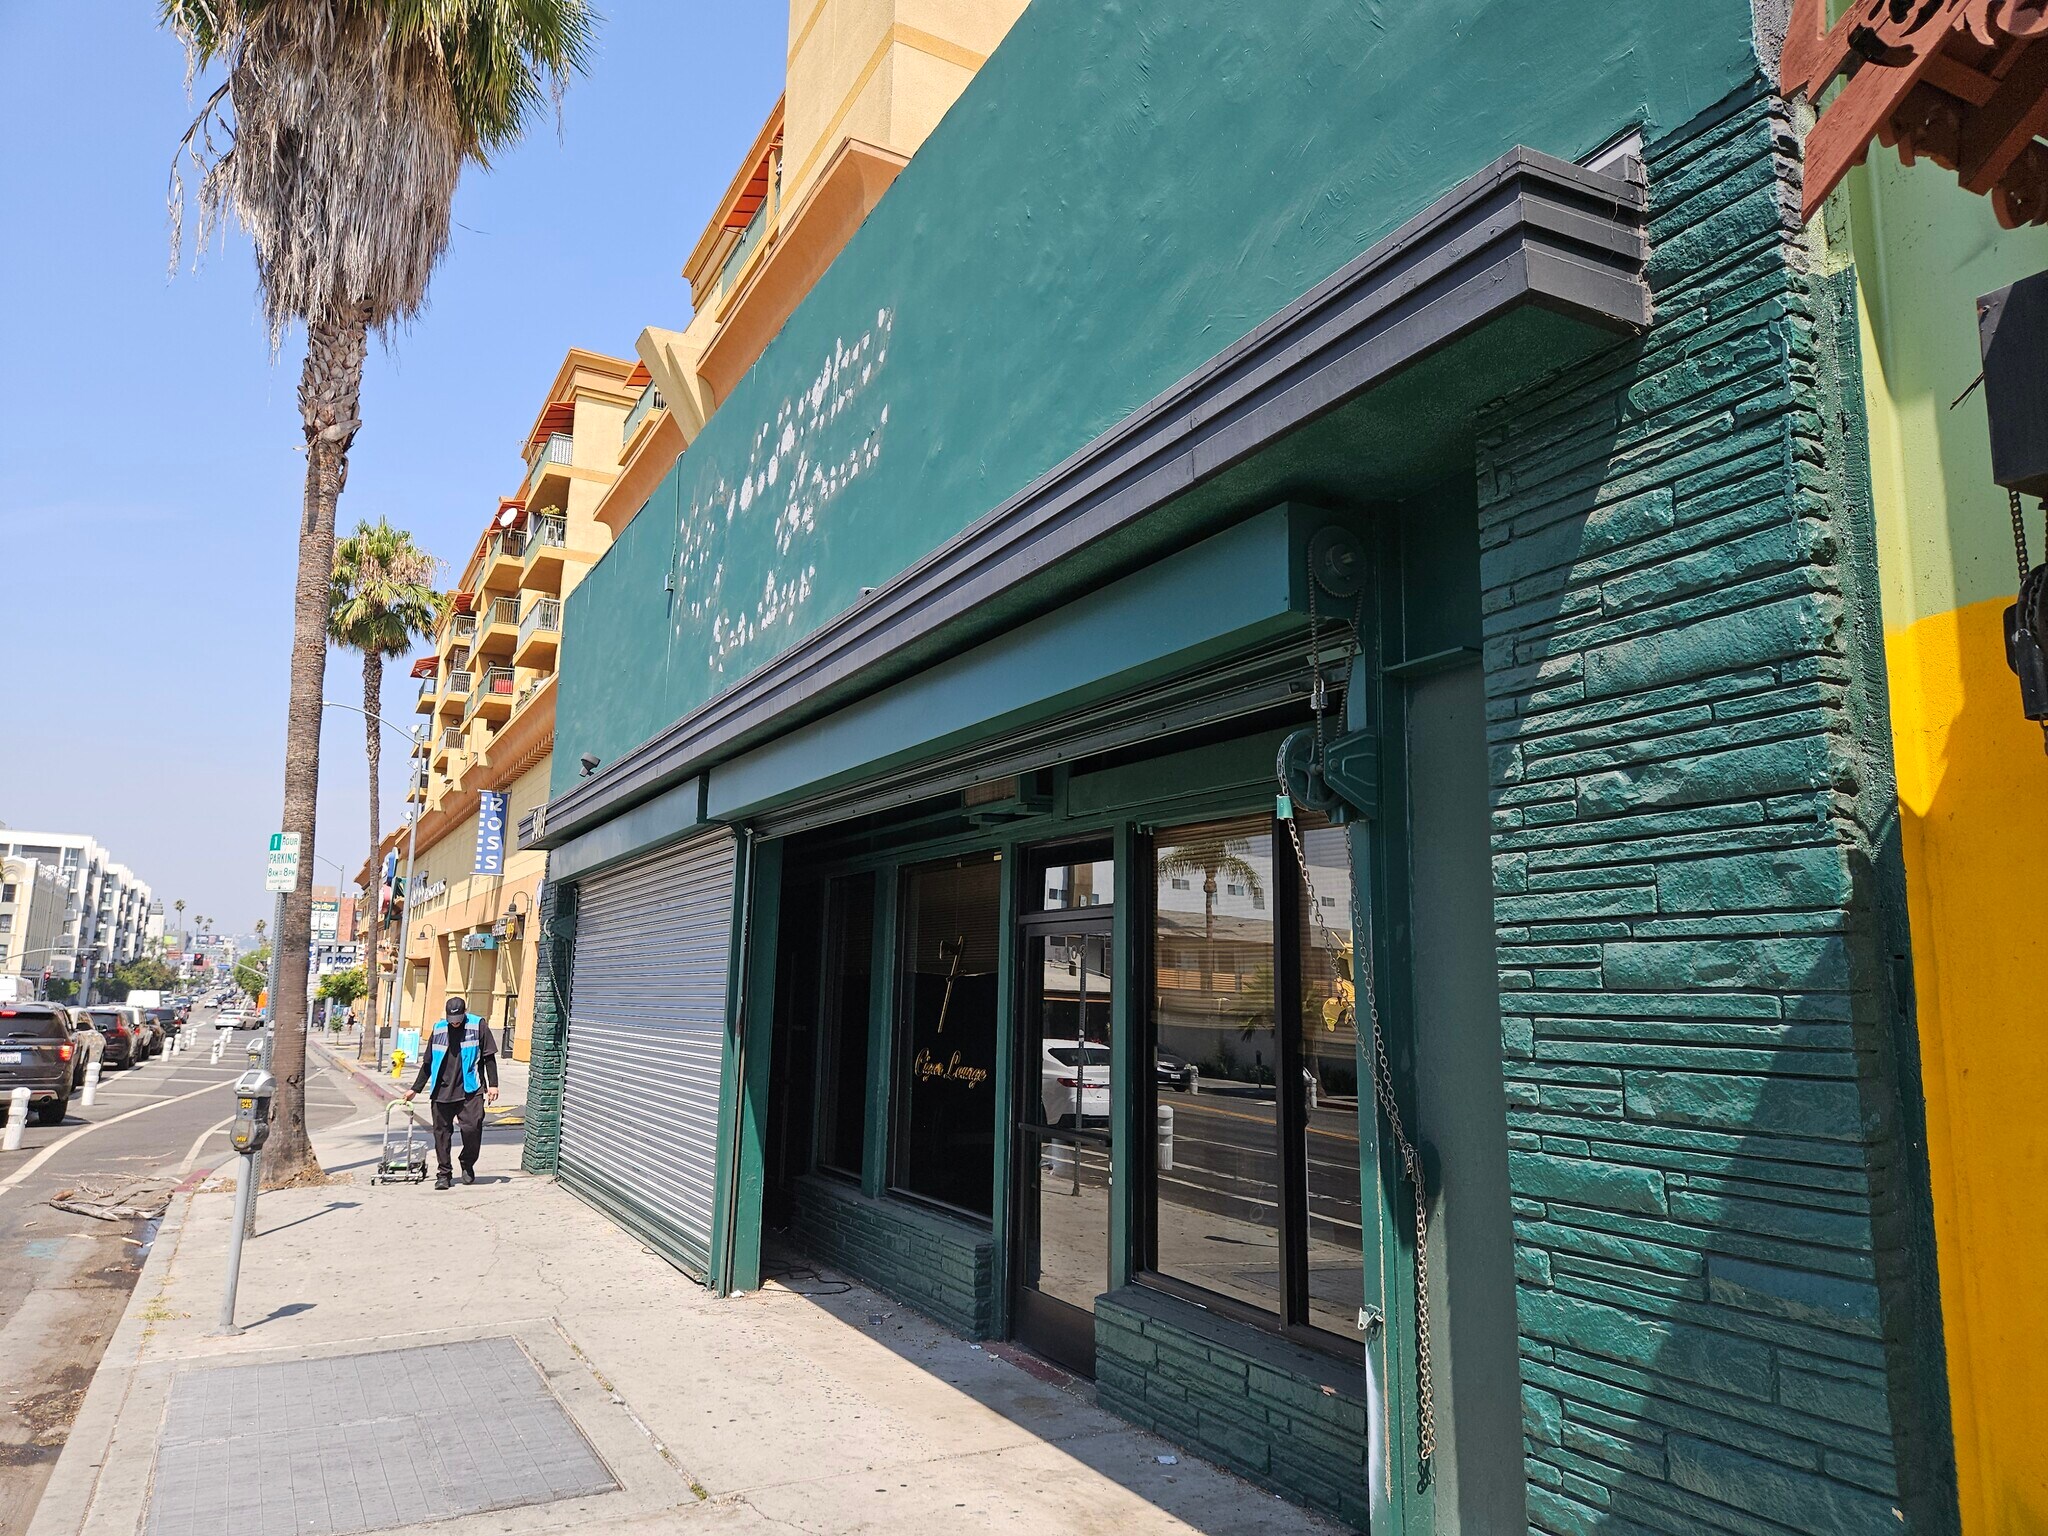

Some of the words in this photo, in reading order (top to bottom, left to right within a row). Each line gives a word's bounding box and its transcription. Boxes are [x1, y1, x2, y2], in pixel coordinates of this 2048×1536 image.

[484, 797, 503, 870] ROSS
[273, 835, 278, 849] 1
[269, 852, 297, 864] PARKING
[283, 867, 295, 877] 8PM
[327, 956, 353, 965] petco
[943, 1050, 987, 1089] Lounge
